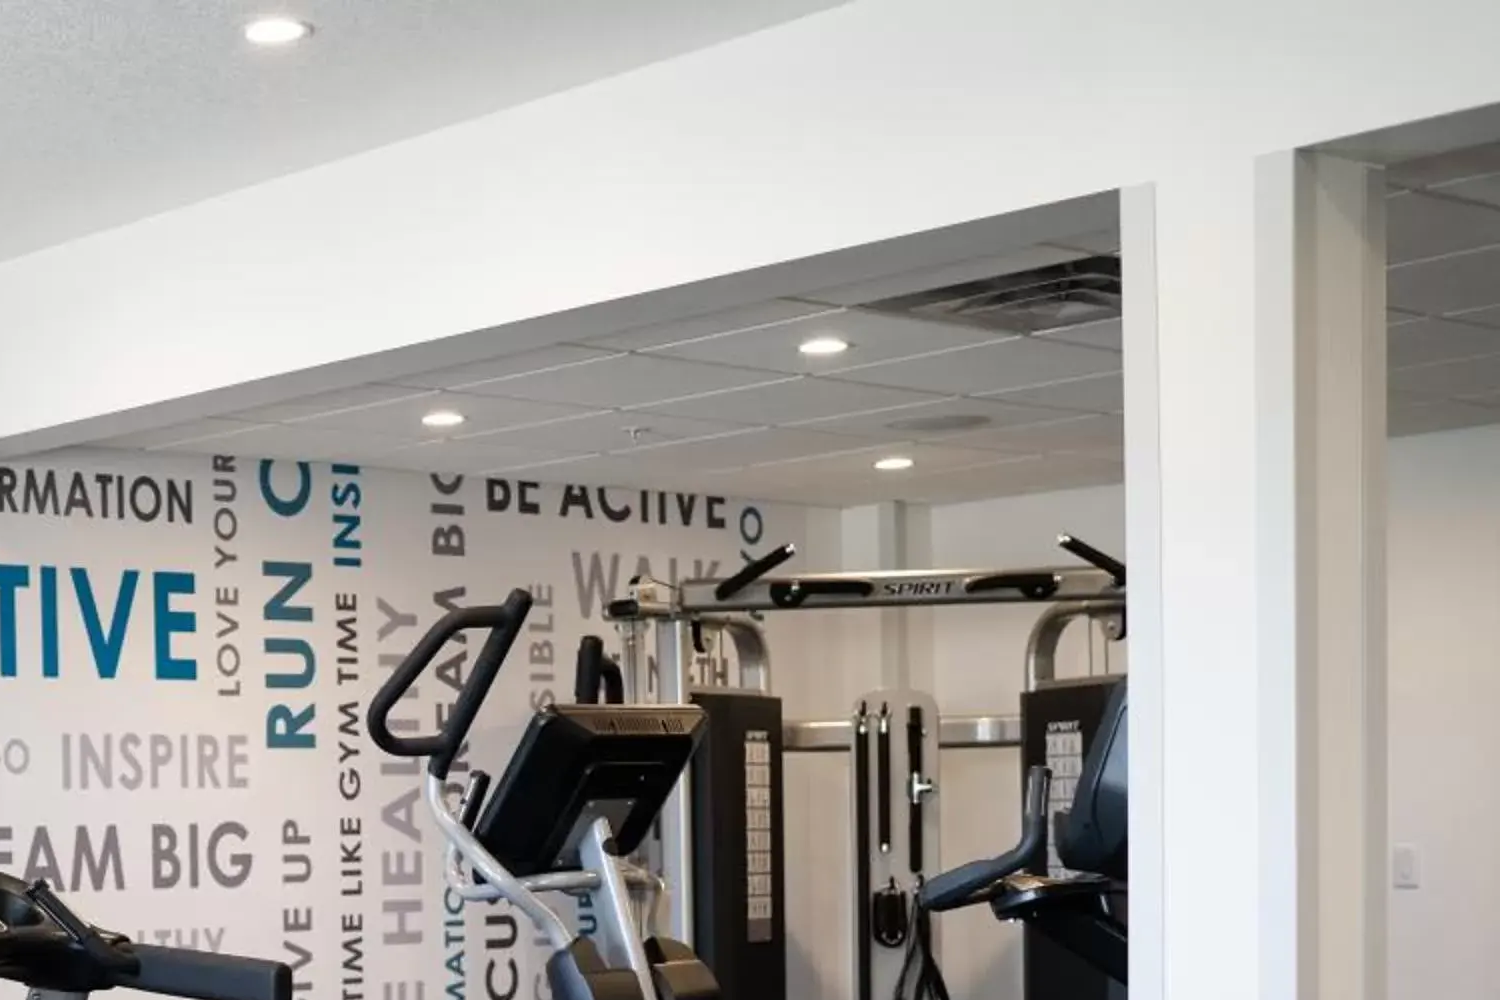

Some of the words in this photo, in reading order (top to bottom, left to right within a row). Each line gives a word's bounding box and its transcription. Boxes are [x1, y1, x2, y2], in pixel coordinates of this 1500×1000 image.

[213, 454, 239, 571] YOUR
[883, 580, 955, 597] SPIRIT
[216, 587, 242, 696] LOVE
[262, 561, 317, 749] RUN
[337, 592, 358, 698] TIME
[61, 732, 249, 791] INSPIRE
[338, 701, 362, 800] GYM
[151, 821, 253, 890] BIG
[282, 819, 313, 884] UP
[338, 816, 362, 897] LIKE
